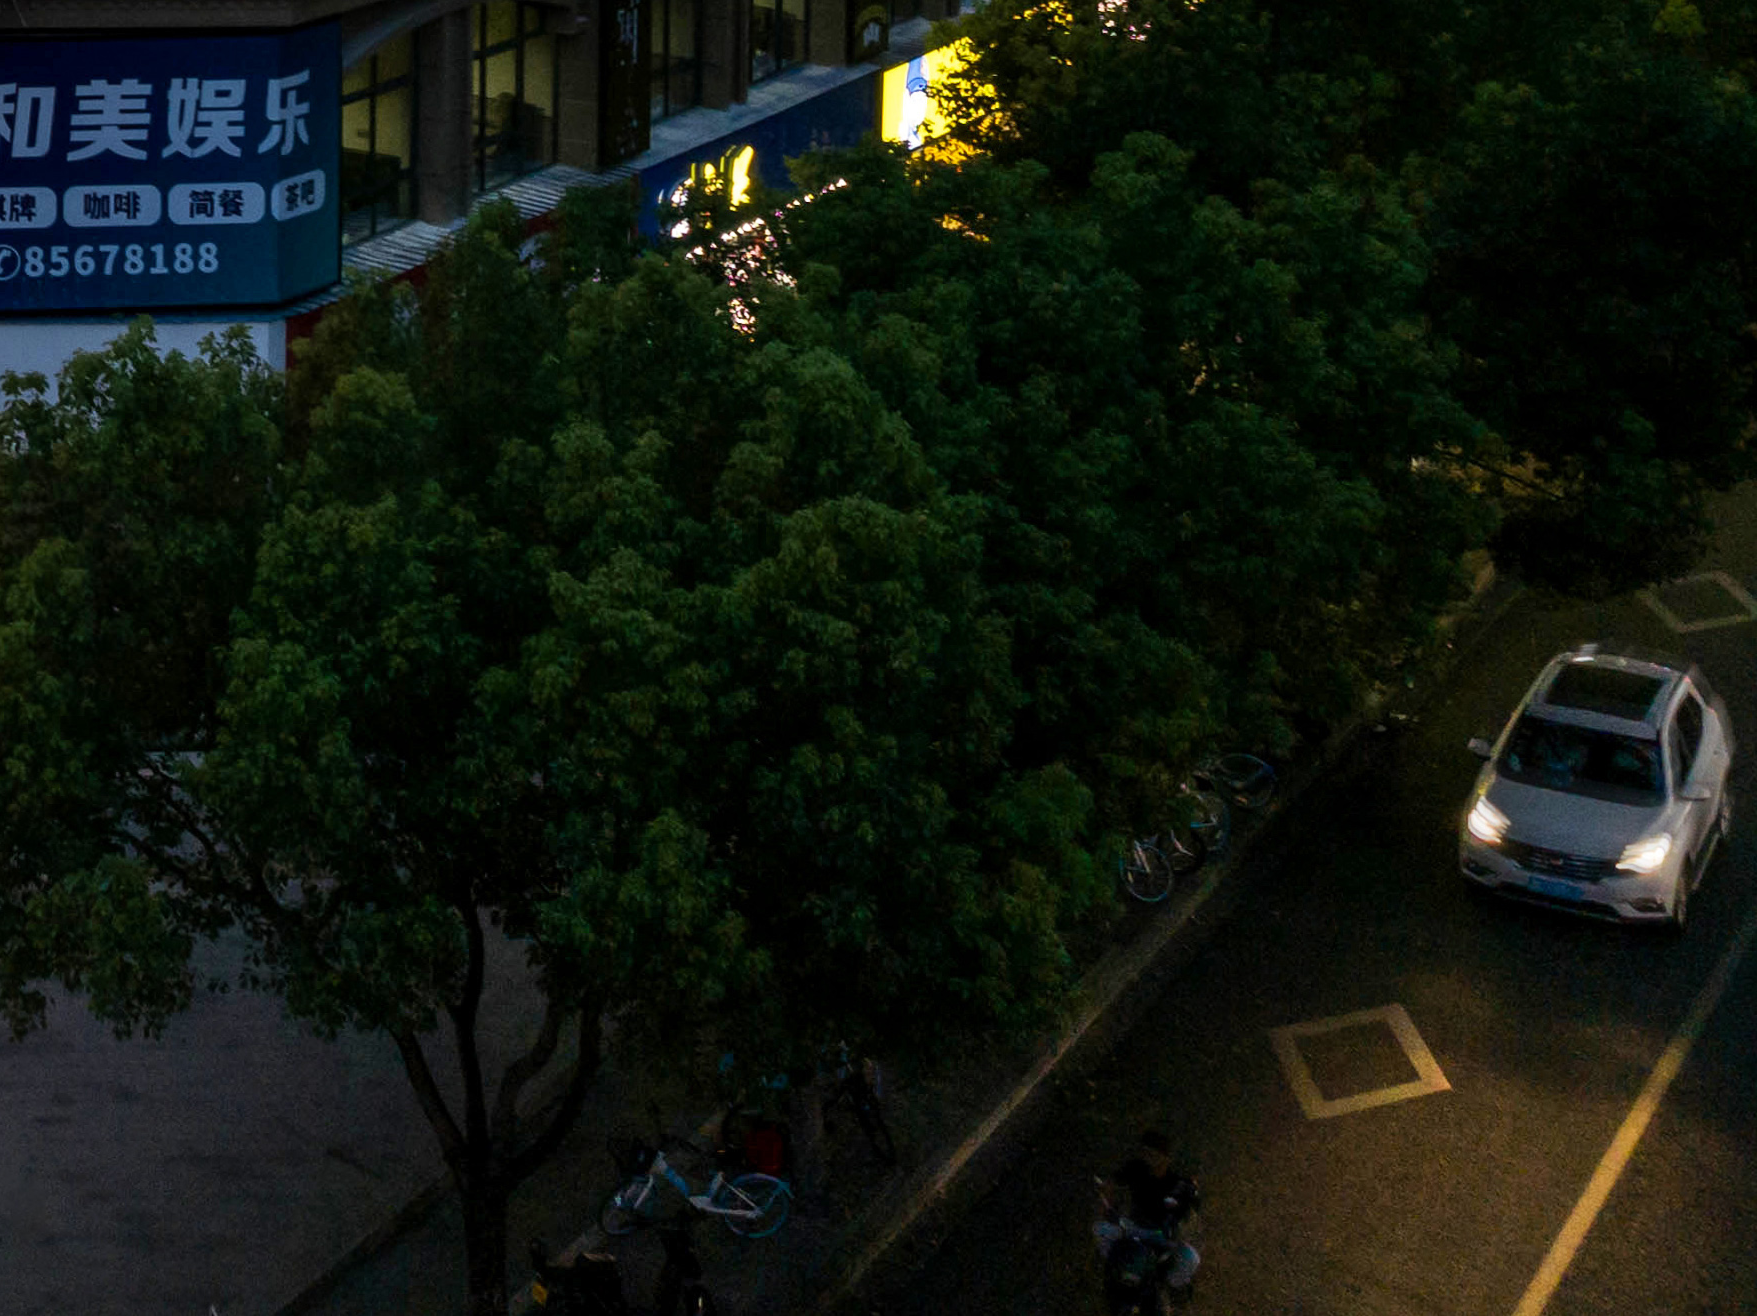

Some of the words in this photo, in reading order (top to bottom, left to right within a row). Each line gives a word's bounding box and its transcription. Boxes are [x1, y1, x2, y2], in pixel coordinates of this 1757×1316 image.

[85, 191, 141, 220] 咖啡
[188, 190, 245, 218] 简餐
[24, 241, 220, 278] 85678188
